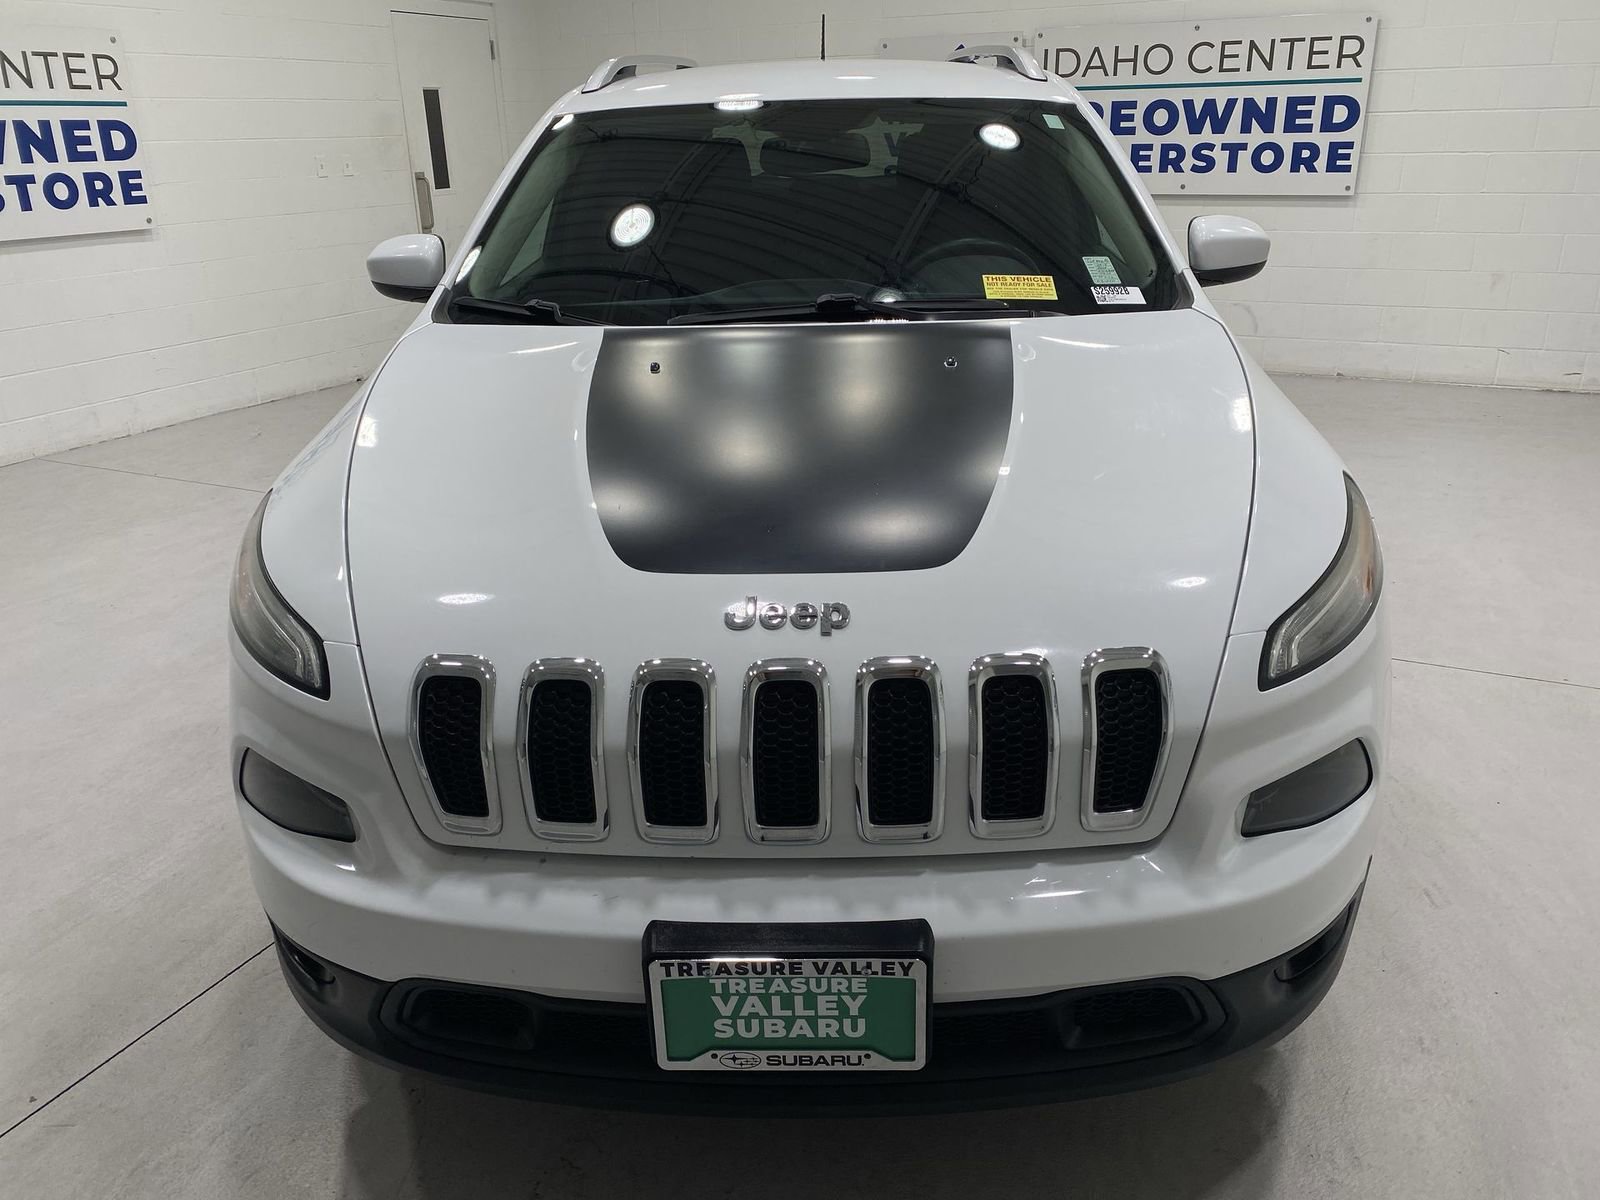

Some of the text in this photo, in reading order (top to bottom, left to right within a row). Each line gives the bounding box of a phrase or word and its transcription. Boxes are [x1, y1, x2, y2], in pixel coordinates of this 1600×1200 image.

[1043, 34, 1366, 78] IDAHO CENTER
[0, 119, 138, 165] NED
[0, 169, 149, 212] TORE
[724, 595, 850, 637] Jeep
[659, 960, 915, 978] TREASURE VALLEY
[708, 977, 868, 994] TREASURE
[710, 995, 868, 1017] VALLEY
[714, 1017, 867, 1039] SUBARU
